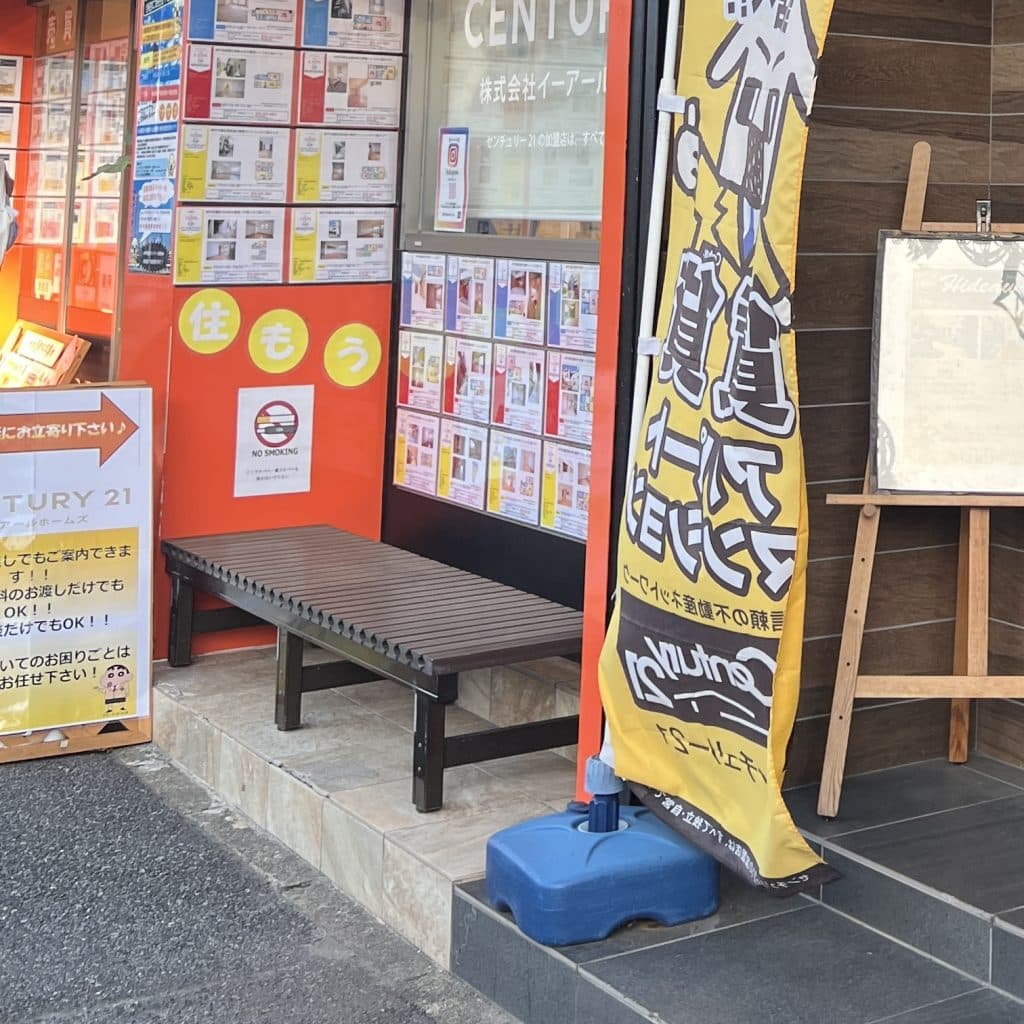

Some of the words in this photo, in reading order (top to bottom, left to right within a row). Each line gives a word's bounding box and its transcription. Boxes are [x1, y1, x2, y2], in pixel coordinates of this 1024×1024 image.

[189, 301, 369, 374] 住もう
[264, 448, 298, 456] SMOKING
[104, 487, 131, 506] 21
[0, 545, 131, 568] してもご案内できま
